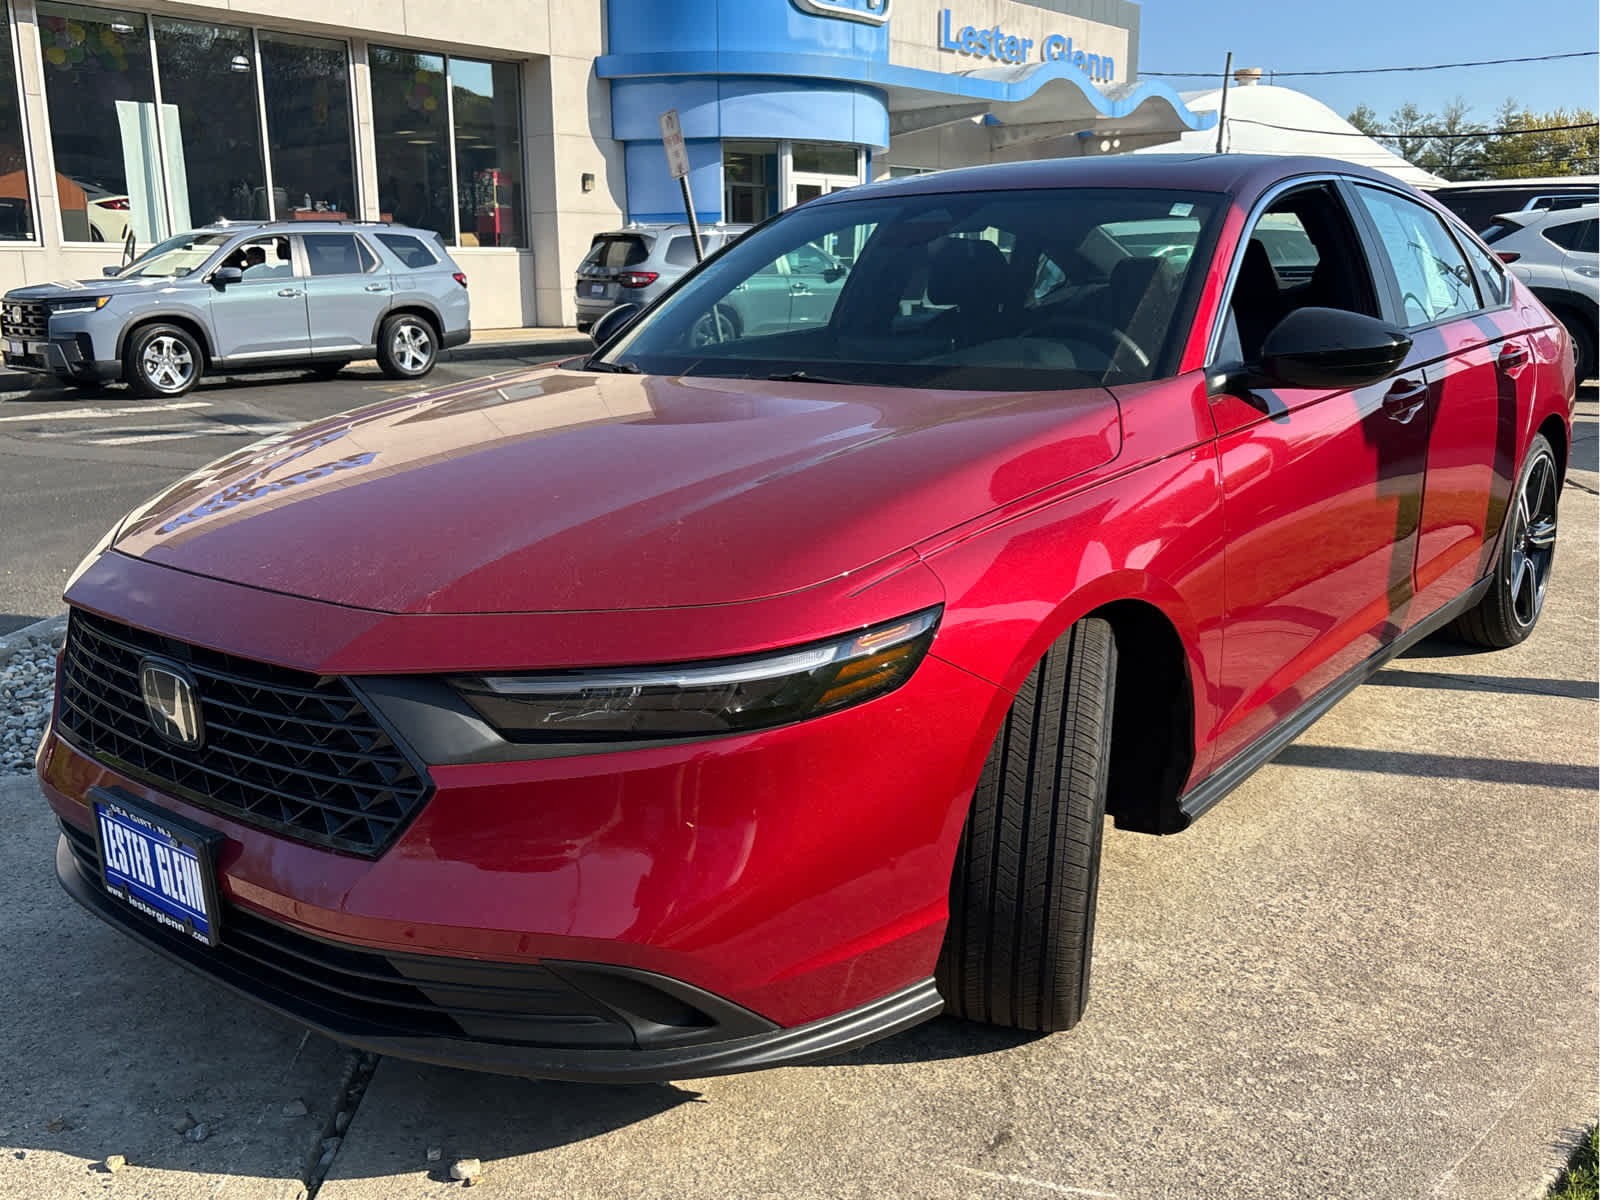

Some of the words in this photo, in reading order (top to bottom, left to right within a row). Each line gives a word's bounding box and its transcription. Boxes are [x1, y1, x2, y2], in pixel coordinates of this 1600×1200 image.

[942, 8, 1034, 63] Lester
[1045, 34, 1115, 81] Glenn
[109, 803, 129, 819] SEA
[100, 816, 155, 889] LESTER
[154, 843, 207, 915] GLENN
[128, 895, 185, 933] lesterglenn
